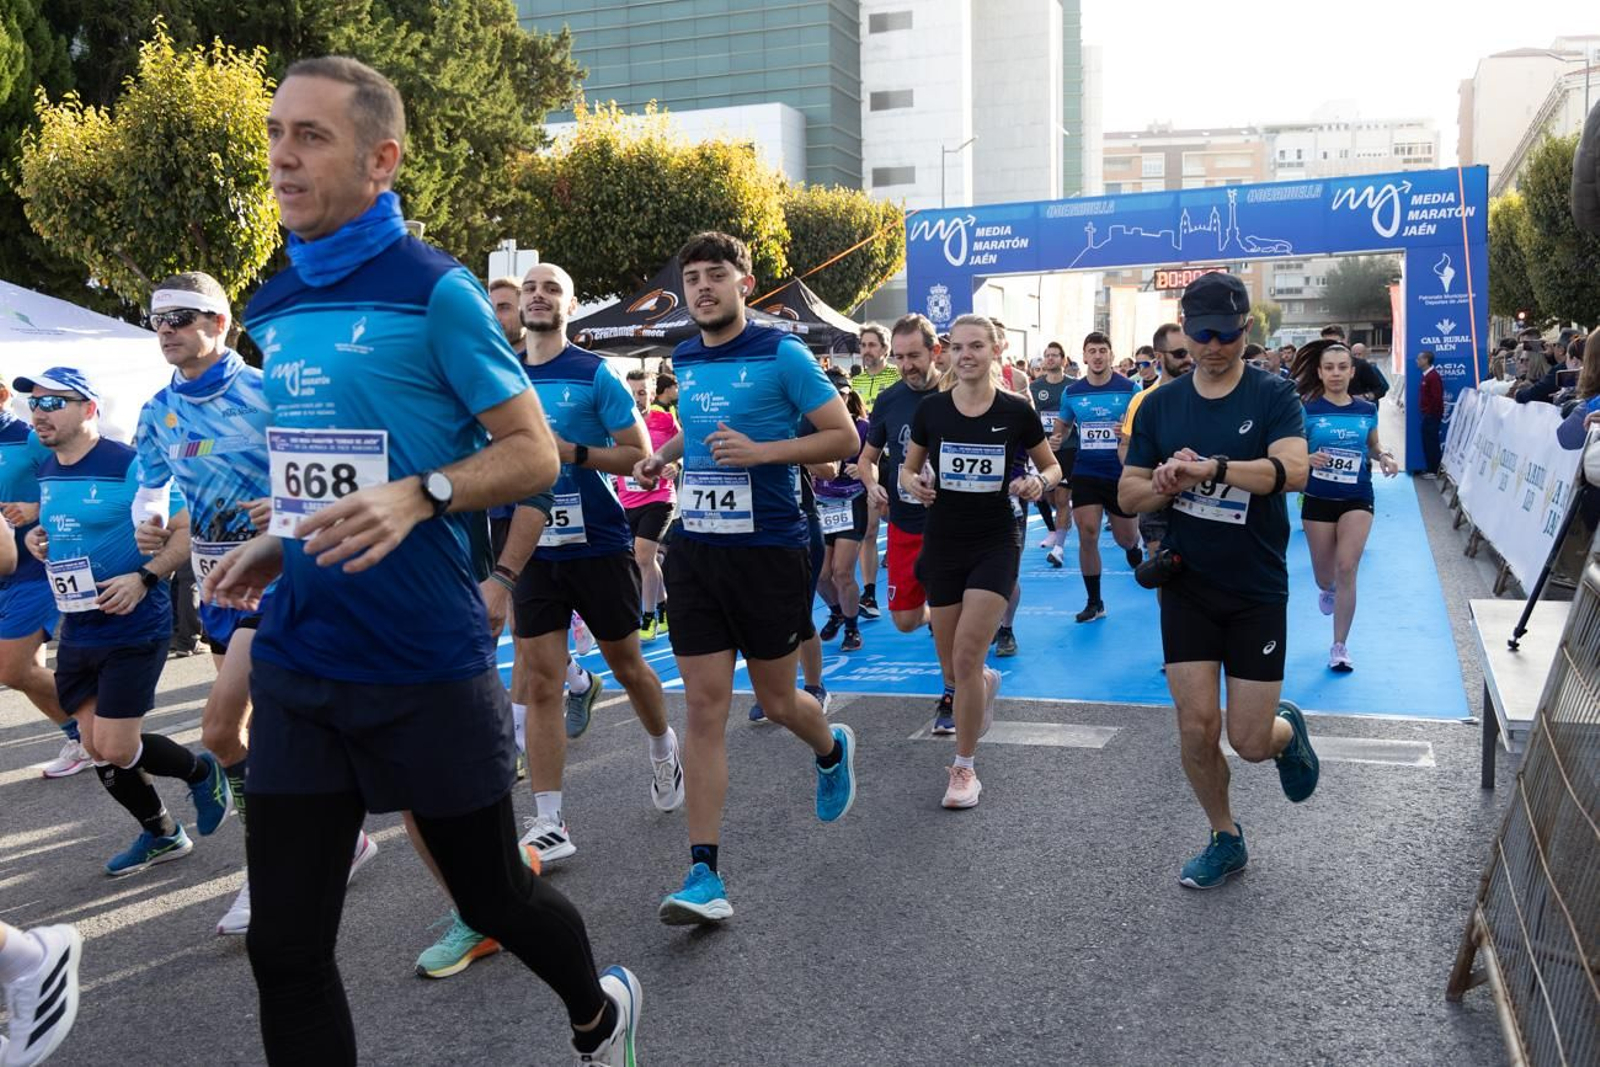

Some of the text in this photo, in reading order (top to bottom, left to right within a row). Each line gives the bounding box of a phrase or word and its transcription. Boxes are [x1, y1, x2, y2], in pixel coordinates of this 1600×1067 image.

[1411, 192, 1455, 206] MEDIA
[1407, 204, 1475, 221] MARATÓN
[976, 226, 1012, 237] MEDIA
[1402, 222, 1436, 237] JAÉN
[973, 237, 1029, 251] MARATÓN
[969, 253, 997, 266] JAÉN
[1421, 335, 1472, 344] CAJA RURAL
[1435, 344, 1456, 352] JAÉN
[1087, 430, 1110, 439] 670
[952, 457, 992, 474] 978
[285, 461, 359, 499] 668
[692, 490, 737, 510] 714
[824, 512, 849, 526] 696
